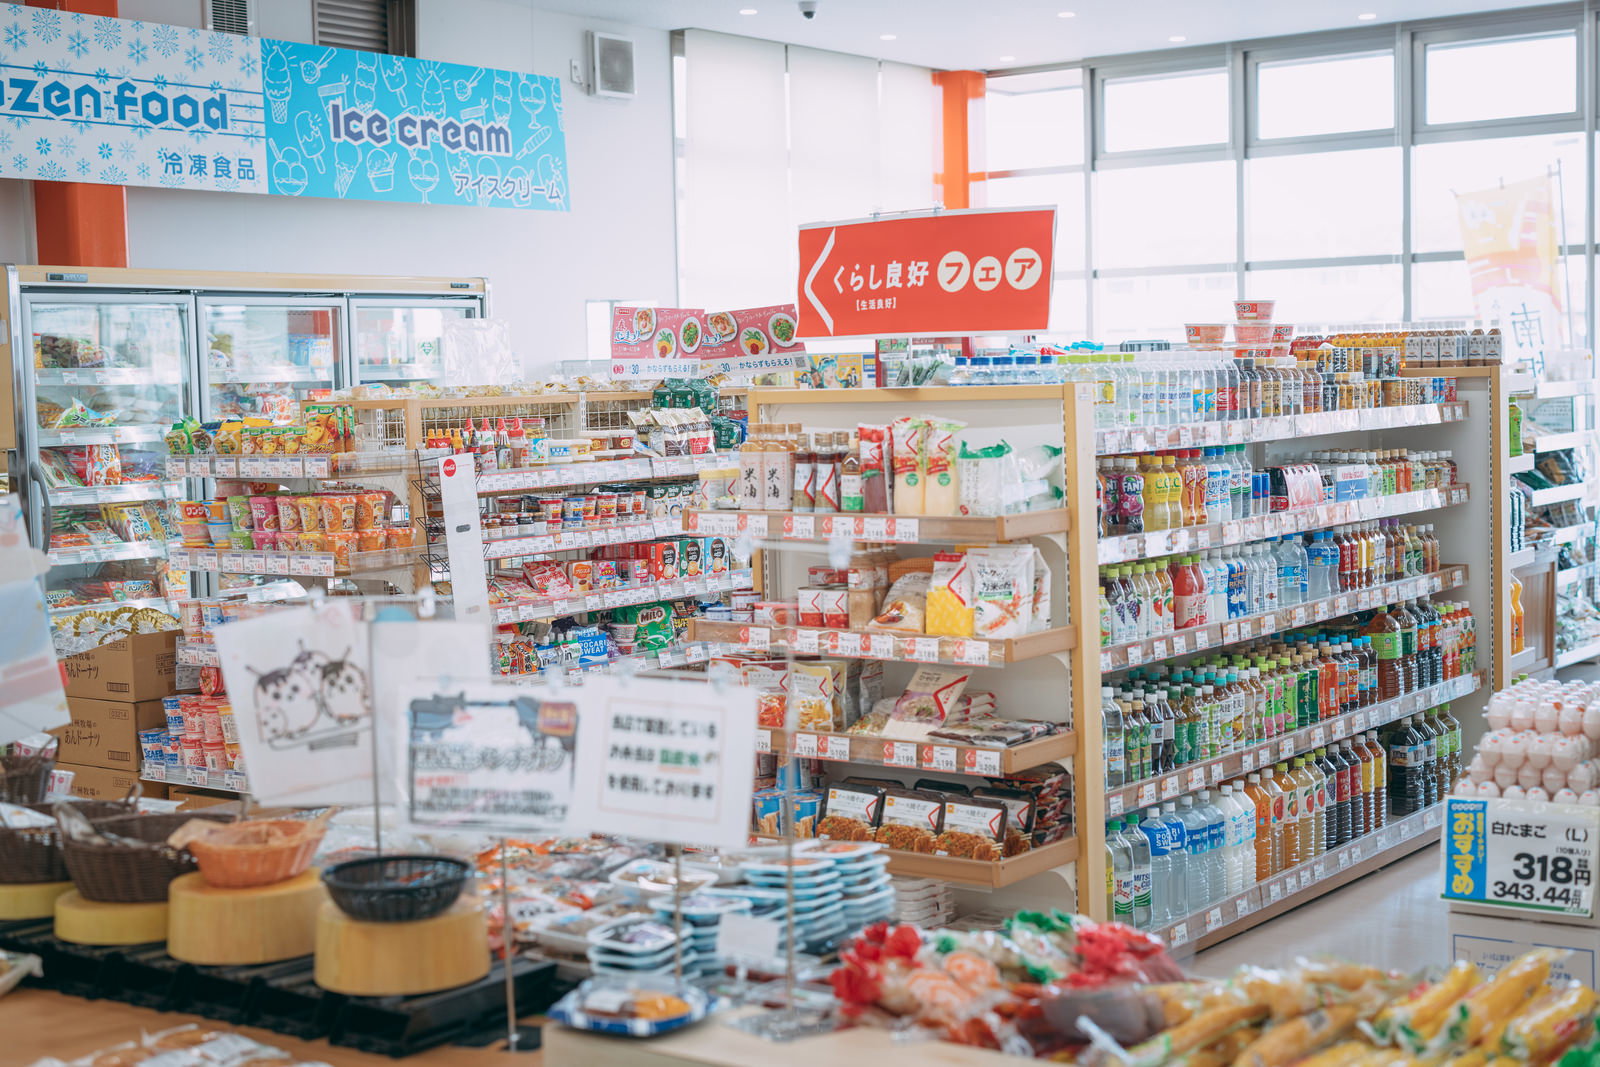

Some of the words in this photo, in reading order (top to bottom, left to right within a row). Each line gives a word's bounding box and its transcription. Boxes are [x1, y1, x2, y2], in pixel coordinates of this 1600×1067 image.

[114, 81, 229, 130] food
[331, 104, 389, 145] Ice
[398, 116, 511, 154] cream
[163, 152, 256, 181] 冷凍食品
[455, 175, 561, 200] アイスクリーム
[833, 261, 929, 294] くらし良好
[943, 255, 1038, 287] フェア
[744, 467, 758, 499] 米油
[768, 467, 780, 499] 米油
[641, 610, 663, 622] MILO
[64, 731, 100, 747] あんドーナツ
[1492, 821, 1547, 839] 白たまご
[1565, 828, 1589, 842] (L)
[1452, 813, 1475, 895] おすすめ
[1513, 853, 1573, 884] 318
[1575, 869, 1591, 886] 円
[1493, 881, 1571, 905] 343.44
